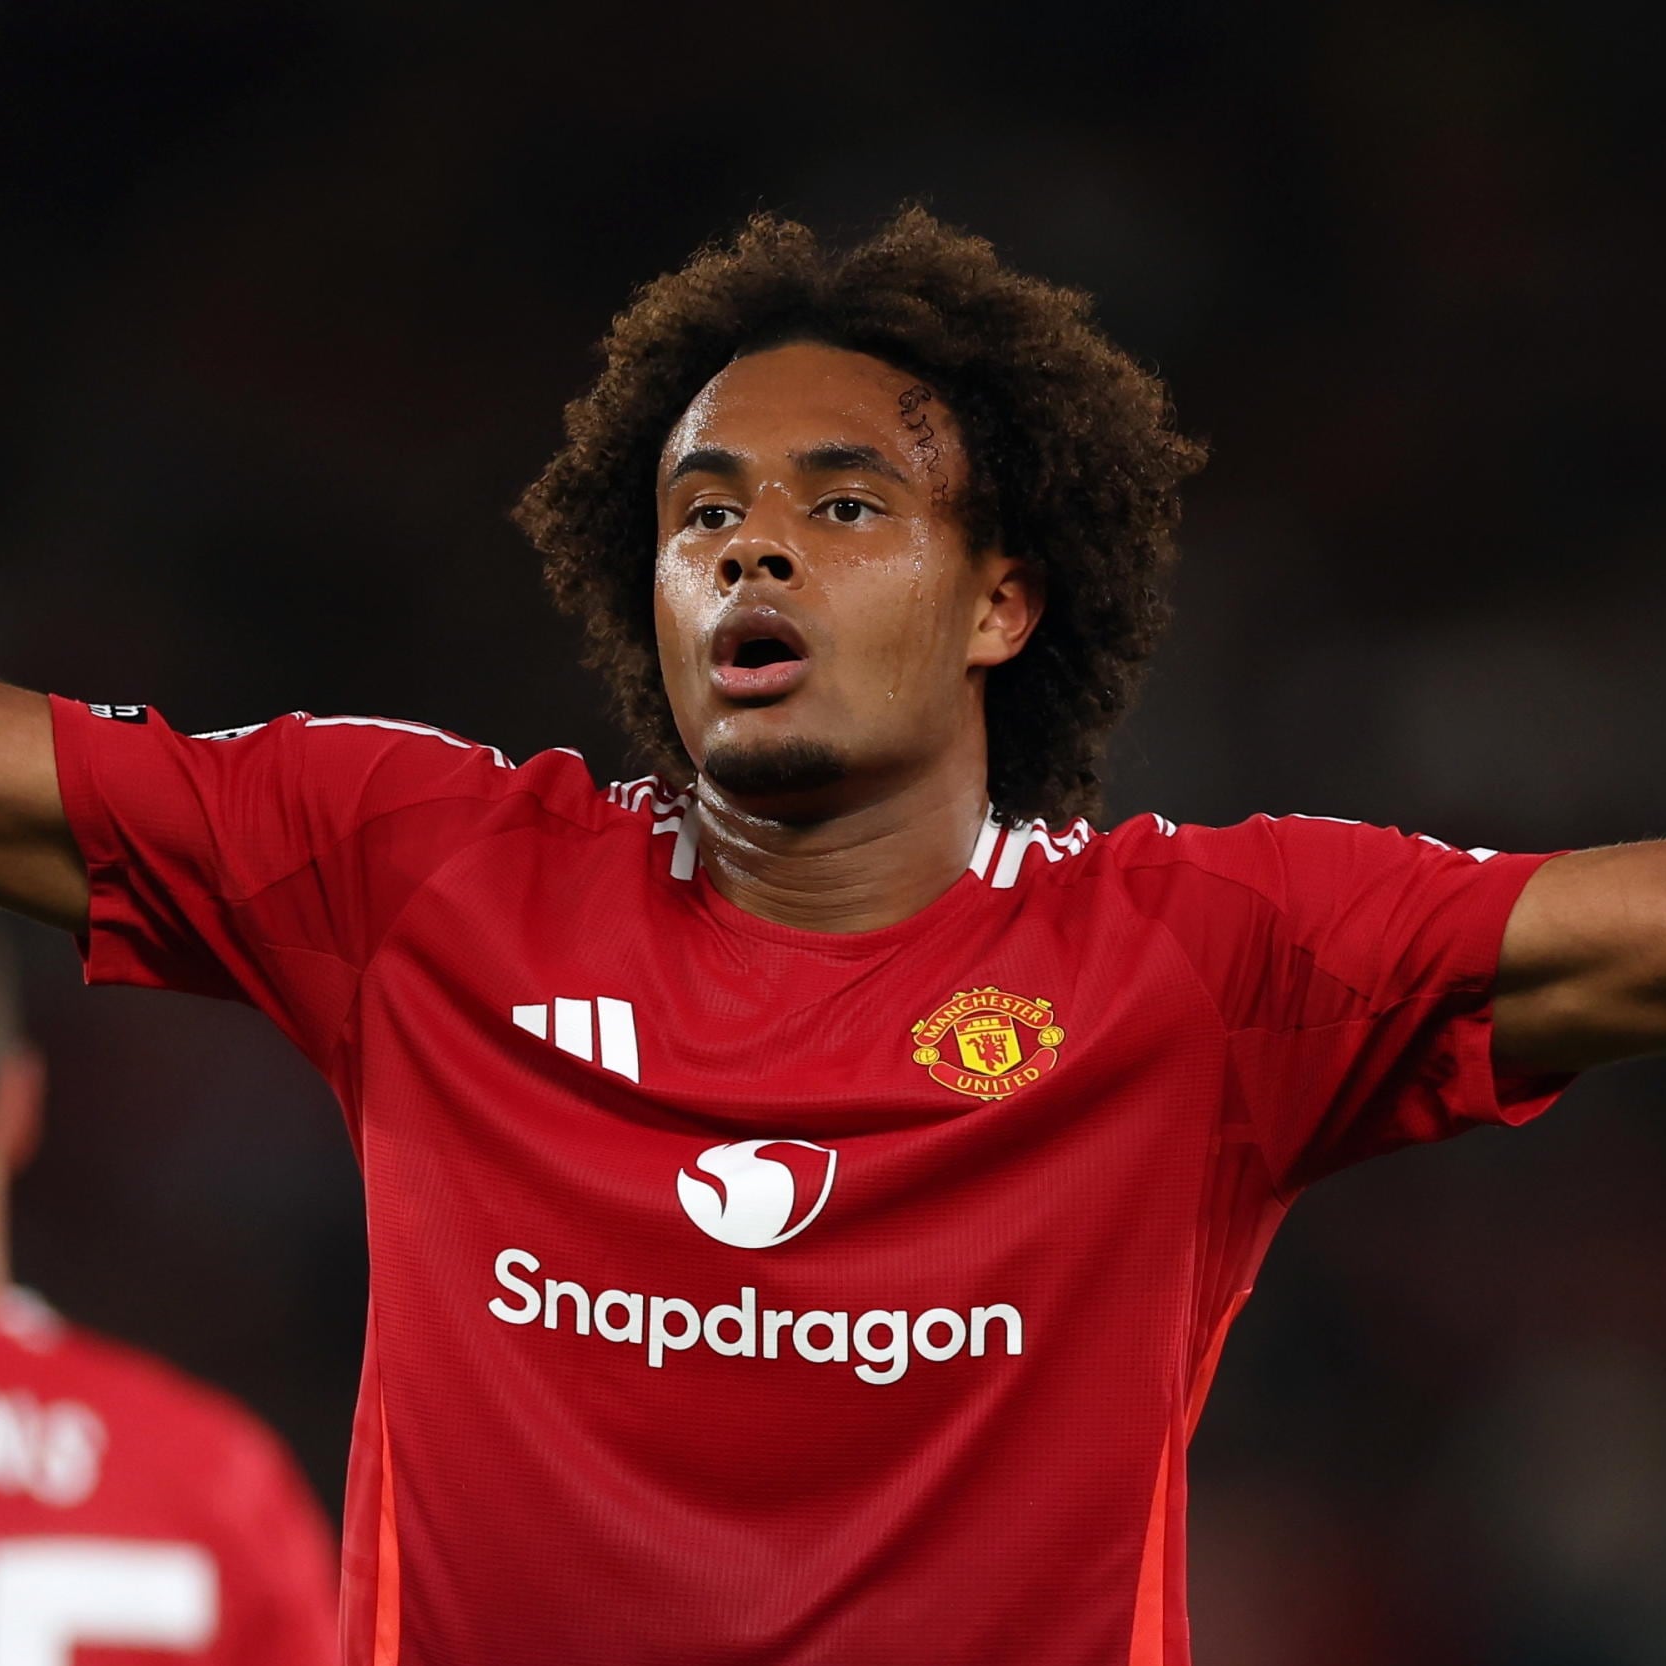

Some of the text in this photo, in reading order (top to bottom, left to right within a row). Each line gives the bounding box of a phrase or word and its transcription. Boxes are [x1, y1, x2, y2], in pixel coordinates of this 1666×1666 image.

[924, 995, 1043, 1039] MANCHESTER
[956, 1067, 1040, 1093] UNITED
[487, 1248, 1023, 1385] Snapdragon
